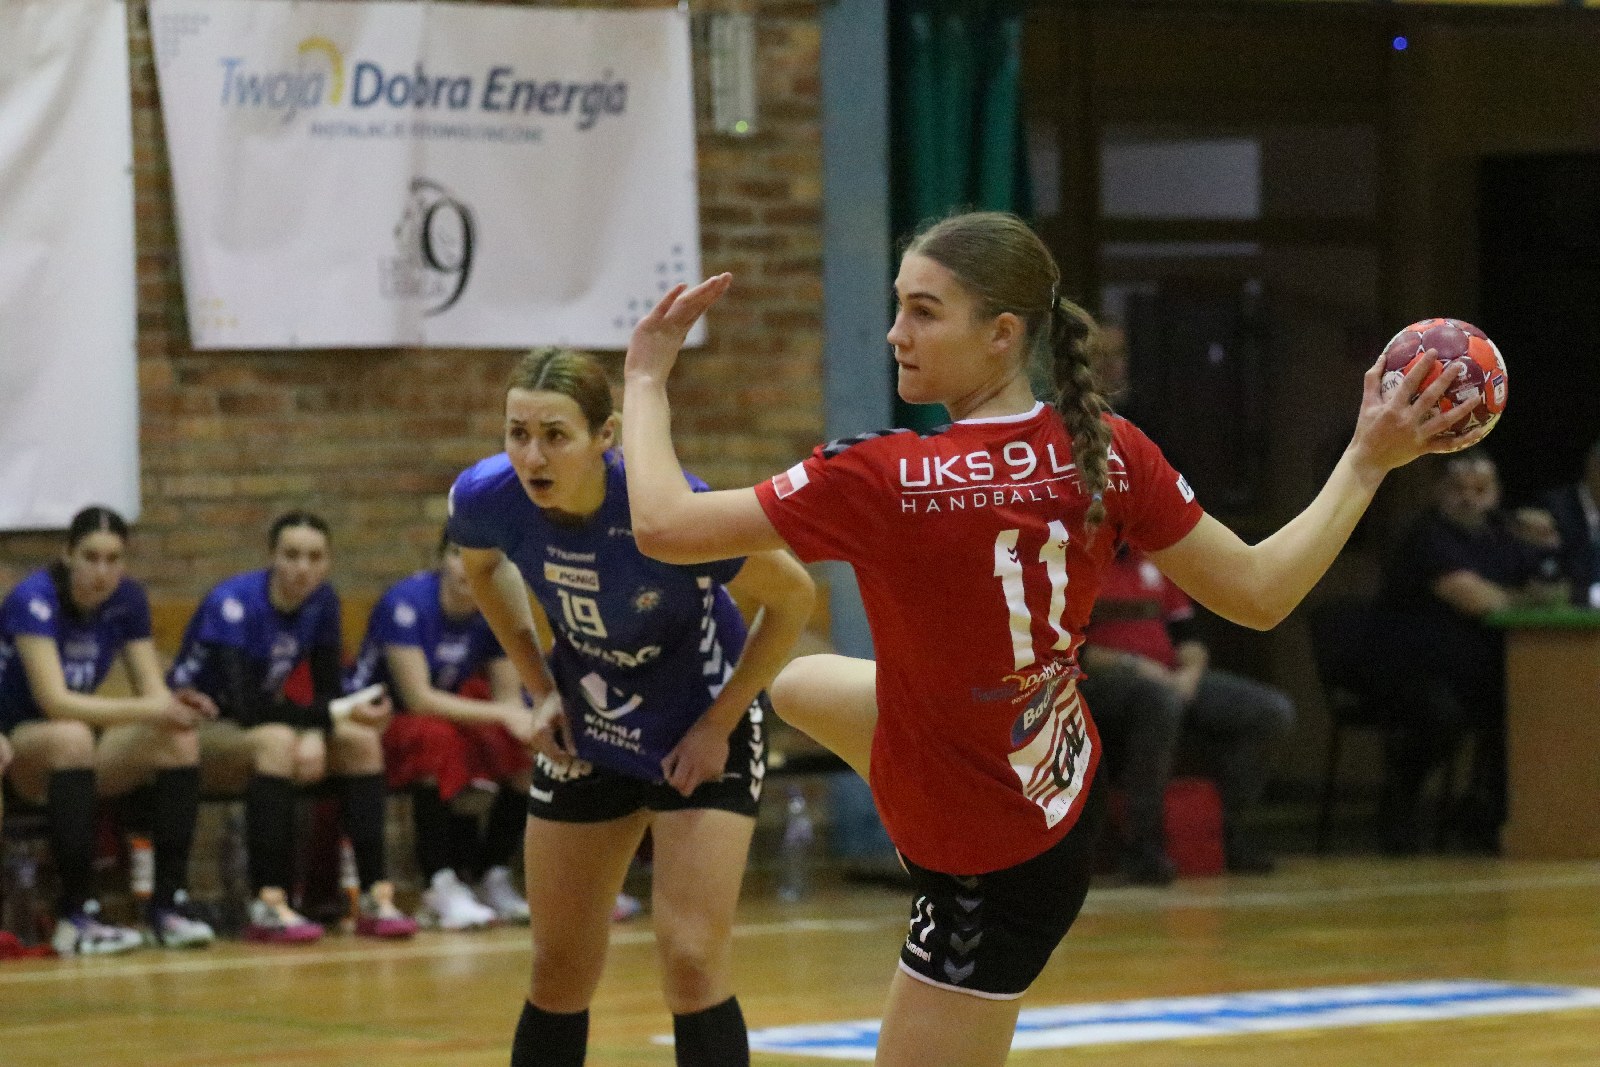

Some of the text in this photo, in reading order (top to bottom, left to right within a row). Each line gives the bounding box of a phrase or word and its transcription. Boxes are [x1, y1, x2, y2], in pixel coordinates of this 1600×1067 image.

[352, 60, 471, 112] Dobra
[480, 65, 628, 131] Energia
[900, 441, 1125, 487] UKS 9 LA
[902, 478, 1130, 513] HANDBALL TAM
[557, 587, 608, 639] 19
[993, 520, 1072, 672] 11
